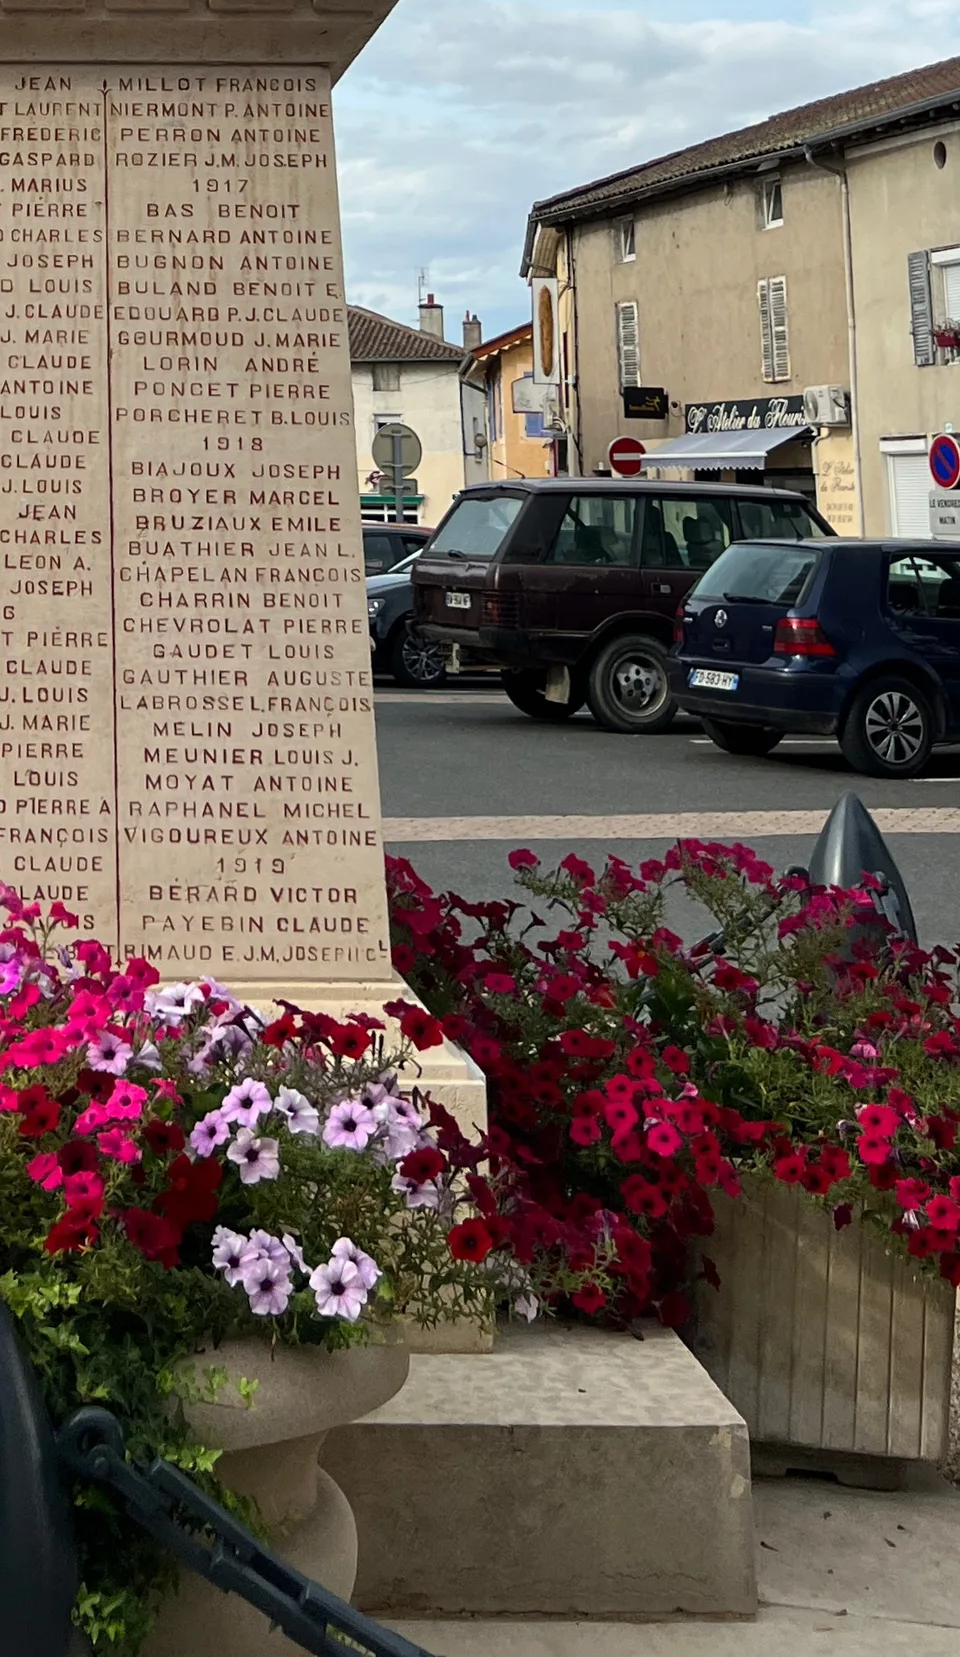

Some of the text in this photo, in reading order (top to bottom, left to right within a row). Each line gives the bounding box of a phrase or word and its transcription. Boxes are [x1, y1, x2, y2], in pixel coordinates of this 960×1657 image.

[15, 77, 70, 90] JEAN
[120, 78, 205, 91] MILLOT
[15, 103, 101, 116] LAURENT
[121, 128, 320, 146] PERRON ANTOINE
[0, 152, 94, 166] GASPARD
[193, 179, 248, 192] 1917
[147, 203, 300, 219] BAS BENOIT
[11, 229, 102, 242] CHARLES
[117, 229, 332, 244] BERNARD ANTOINE
[7, 254, 93, 268] JOSEPH
[117, 255, 333, 272] BUGNON ANTOINE
[30, 279, 92, 293] LOUIS
[0, 330, 16, 343] J.
[25, 330, 89, 344] MARIE
[8, 355, 91, 369] CLAUDE
[144, 352, 319, 373] LORIN ANDRÉ
[0, 380, 93, 398] ANTOINE
[135, 381, 330, 399] PONCET PIERRE
[1, 406, 60, 420] LOUIS
[11, 430, 99, 444] CLAUDE
[203, 437, 262, 451] 1918
[1, 453, 86, 469] CLAUDE
[132, 461, 340, 480] BIAJOUX JOSEPH
[133, 487, 339, 508] BROYER MARCEL
[16, 504, 76, 521] JEAN
[136, 515, 340, 534] BRUZIAUX EMILE
[73, 556, 91, 571] A.
[120, 566, 247, 582] CHAPELAN
[10, 580, 92, 597] JOSEPH
[140, 591, 342, 608] CHARRIN BENOIT
[123, 618, 361, 634] CHEVROLAT PIERRE
[154, 644, 334, 659] GAUDET LOUIS
[7, 660, 91, 676] CLAUDE
[123, 669, 368, 686] GAUTHIER AUGUSTE
[252, 723, 341, 738] JOSEPH
[2, 743, 83, 758] PIERRE
[144, 748, 358, 766] MEUNIER LOUIS J.
[14, 769, 78, 787] LOUIS
[146, 774, 352, 792] MOYAT ANTOINE
[129, 801, 370, 818] RAPHANEL MICHEL
[124, 827, 376, 846] VIGOUREUX ANTOINE
[217, 858, 284, 874] 1919
[270, 887, 357, 903] VICTOR
[277, 917, 369, 934] CLAUDE
